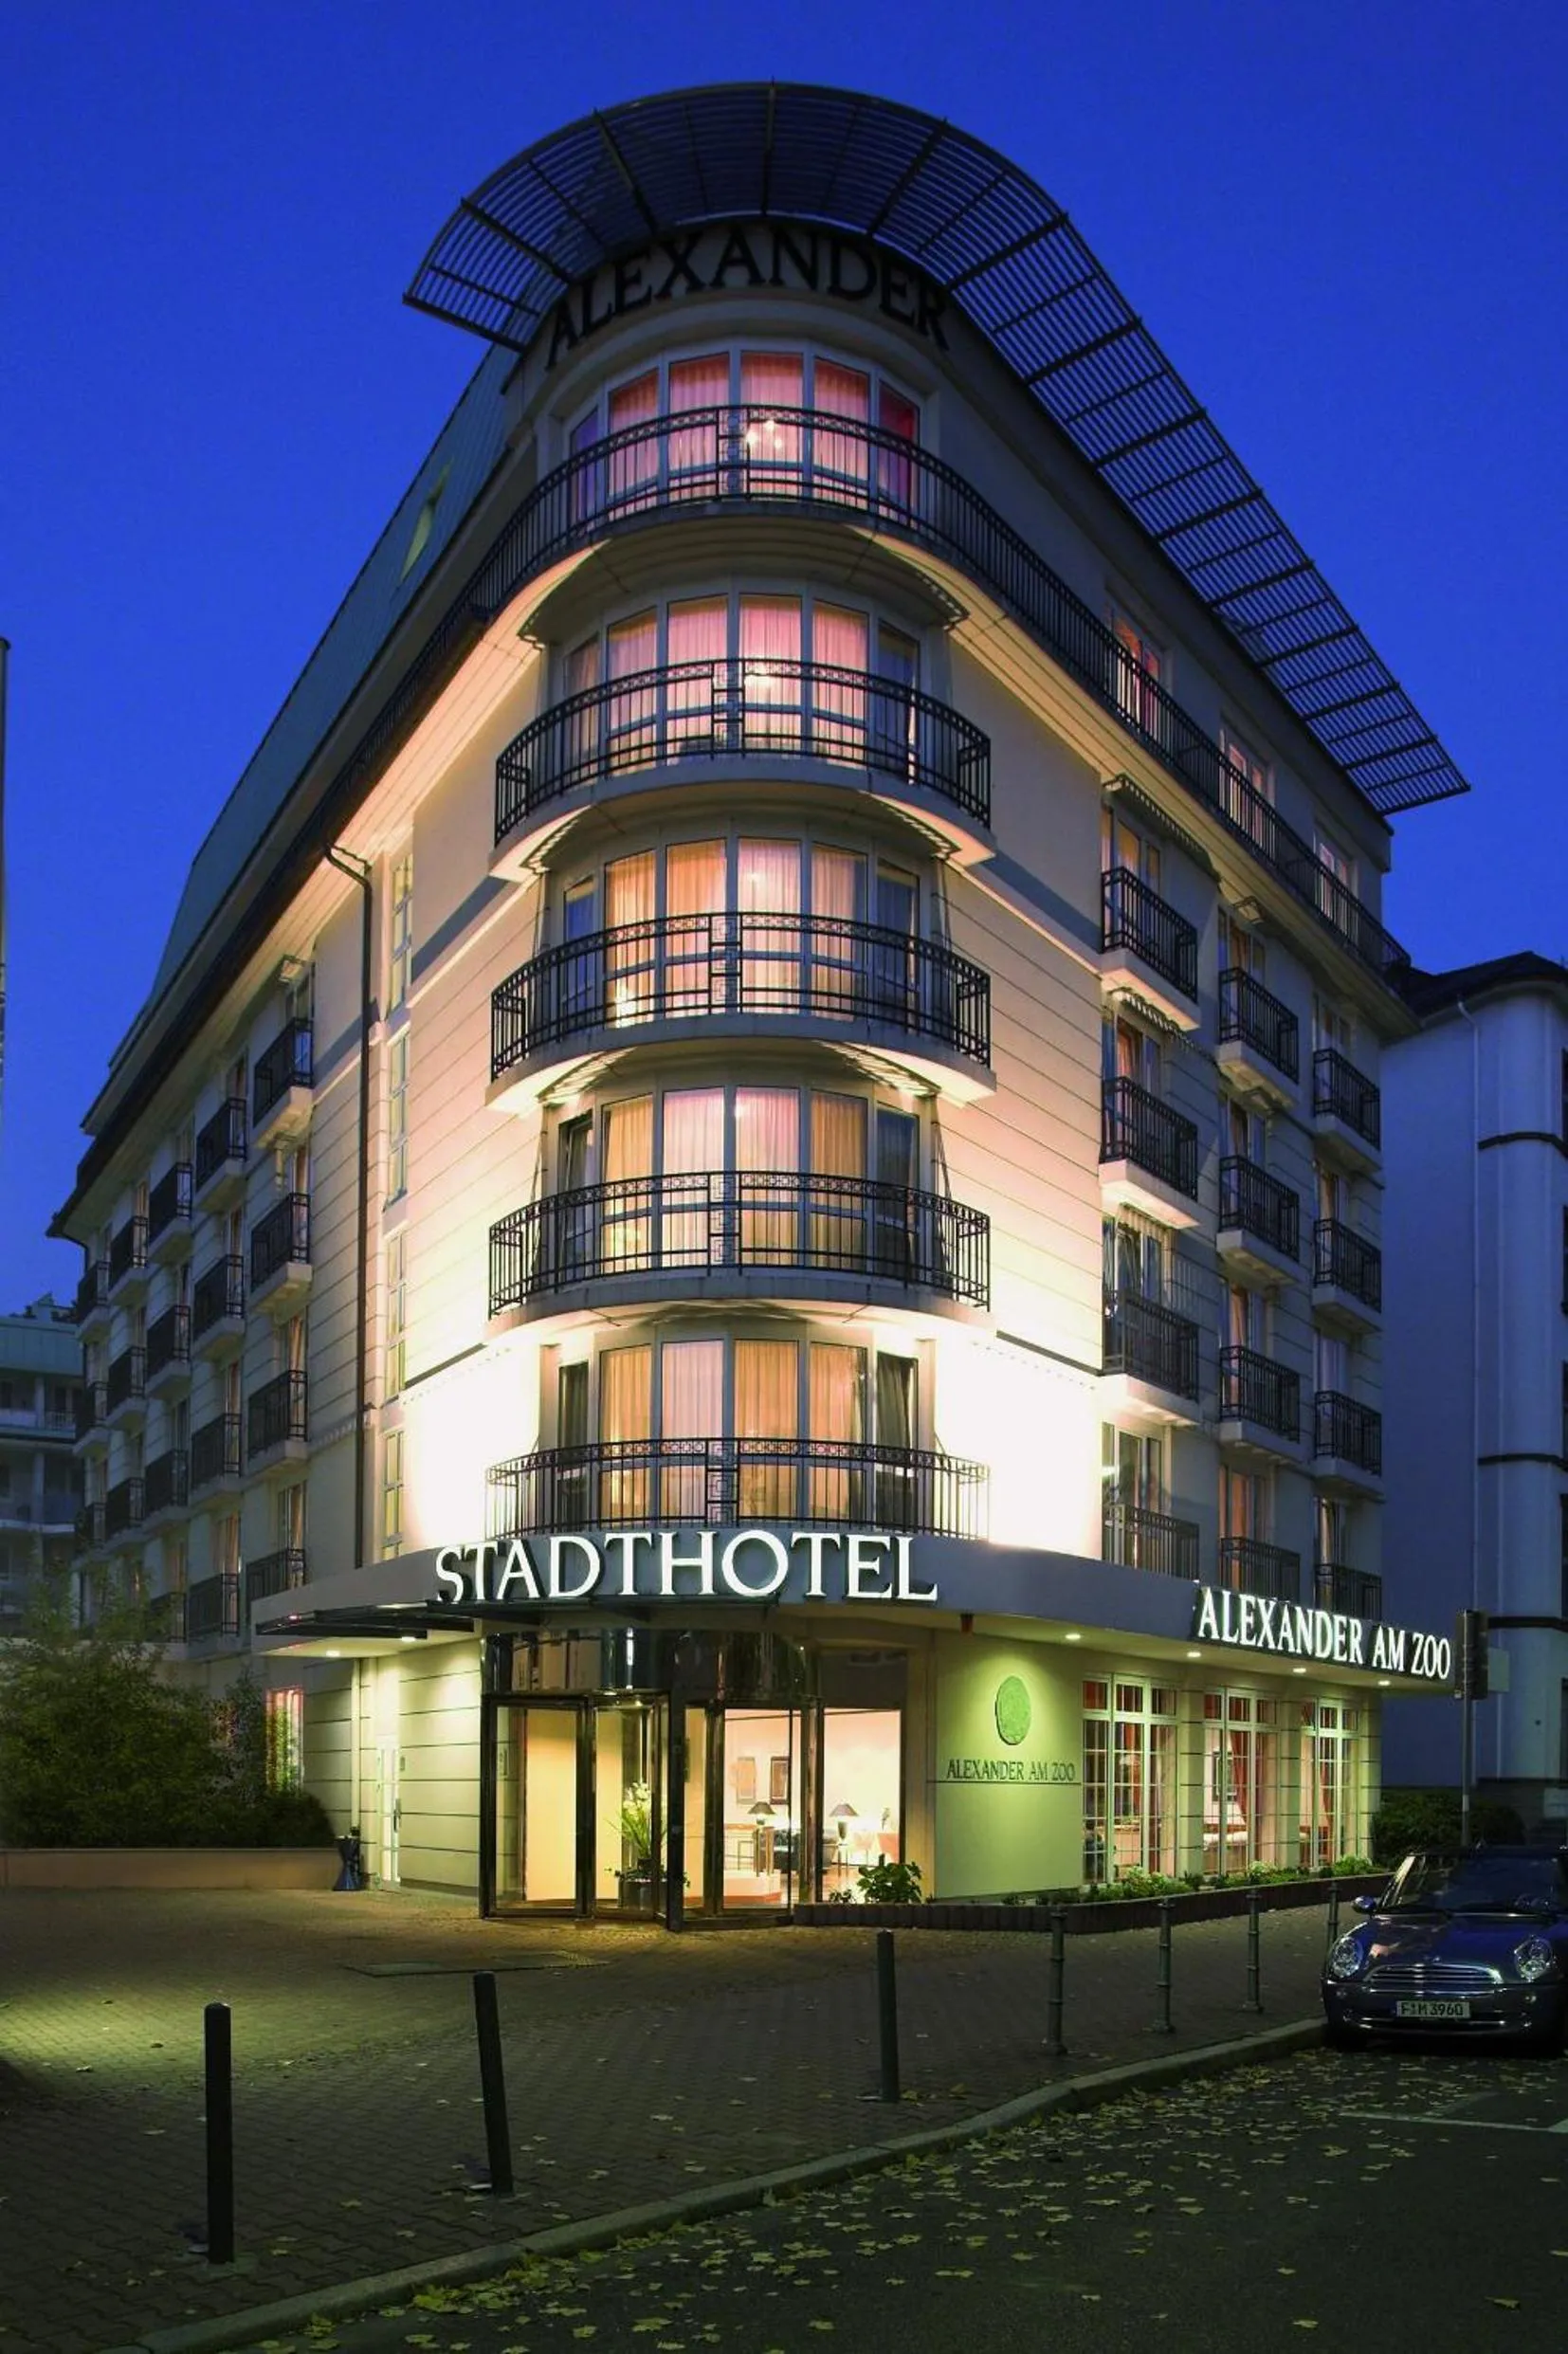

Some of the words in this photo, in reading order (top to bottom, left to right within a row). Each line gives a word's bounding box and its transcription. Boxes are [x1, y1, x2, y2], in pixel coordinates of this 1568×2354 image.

[546, 223, 951, 371] ALEXANDER
[434, 1529, 939, 1602] STADTHOTEL
[1197, 1586, 1363, 1665] ALEXANDER
[1373, 1626, 1406, 1672] AM
[1411, 1633, 1451, 1680] ZOO
[946, 1759, 1025, 1781] ALEXANDER
[1030, 1761, 1048, 1781] AM
[1051, 1762, 1076, 1782] ZOO
